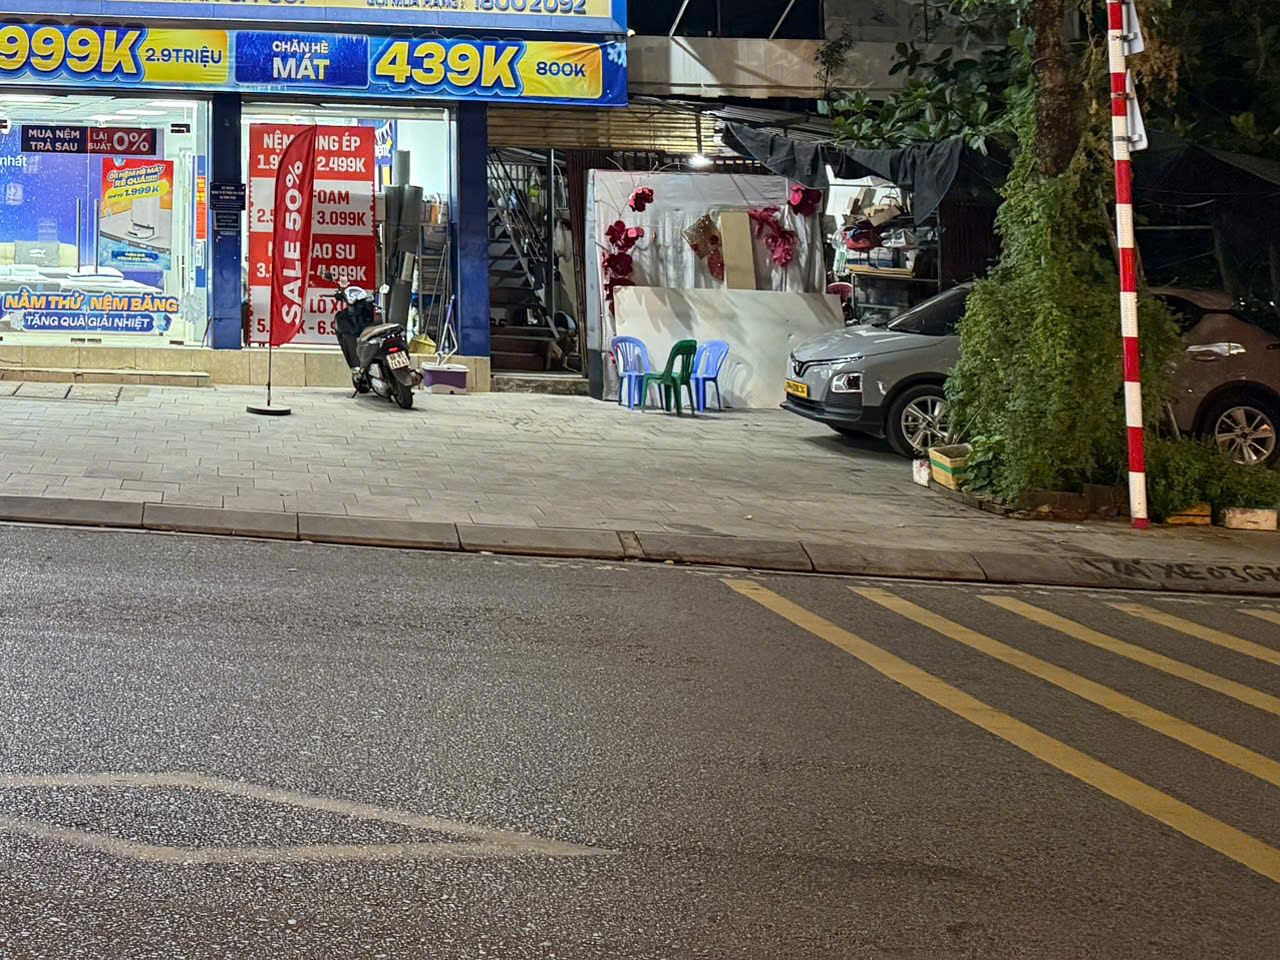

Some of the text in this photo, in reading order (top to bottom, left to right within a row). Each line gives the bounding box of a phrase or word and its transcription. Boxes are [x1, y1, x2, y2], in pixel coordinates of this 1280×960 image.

[272, 41, 329, 54] CHĂN HÈ
[272, 54, 329, 81] MÁT
[376, 41, 520, 89] 439K
[536, 61, 586, 77] 800K
[28, 129, 80, 140] MUA NỆM
[113, 132, 149, 152] 0%
[342, 132, 361, 152] ÉP
[30, 139, 78, 152] TRẢ SAU
[317, 157, 366, 172] 2.499K
[285, 161, 303, 231] 50%
[317, 211, 366, 226] 3.099K
[336, 244, 356, 260] SU
[282, 241, 302, 325] SALE
[91, 295, 129, 314] NỆM
[131, 295, 178, 313] BĂNG
[26, 314, 58, 328] TẶNG
[61, 315, 86, 328] QUÀ
[114, 316, 150, 330] NHIỆT
